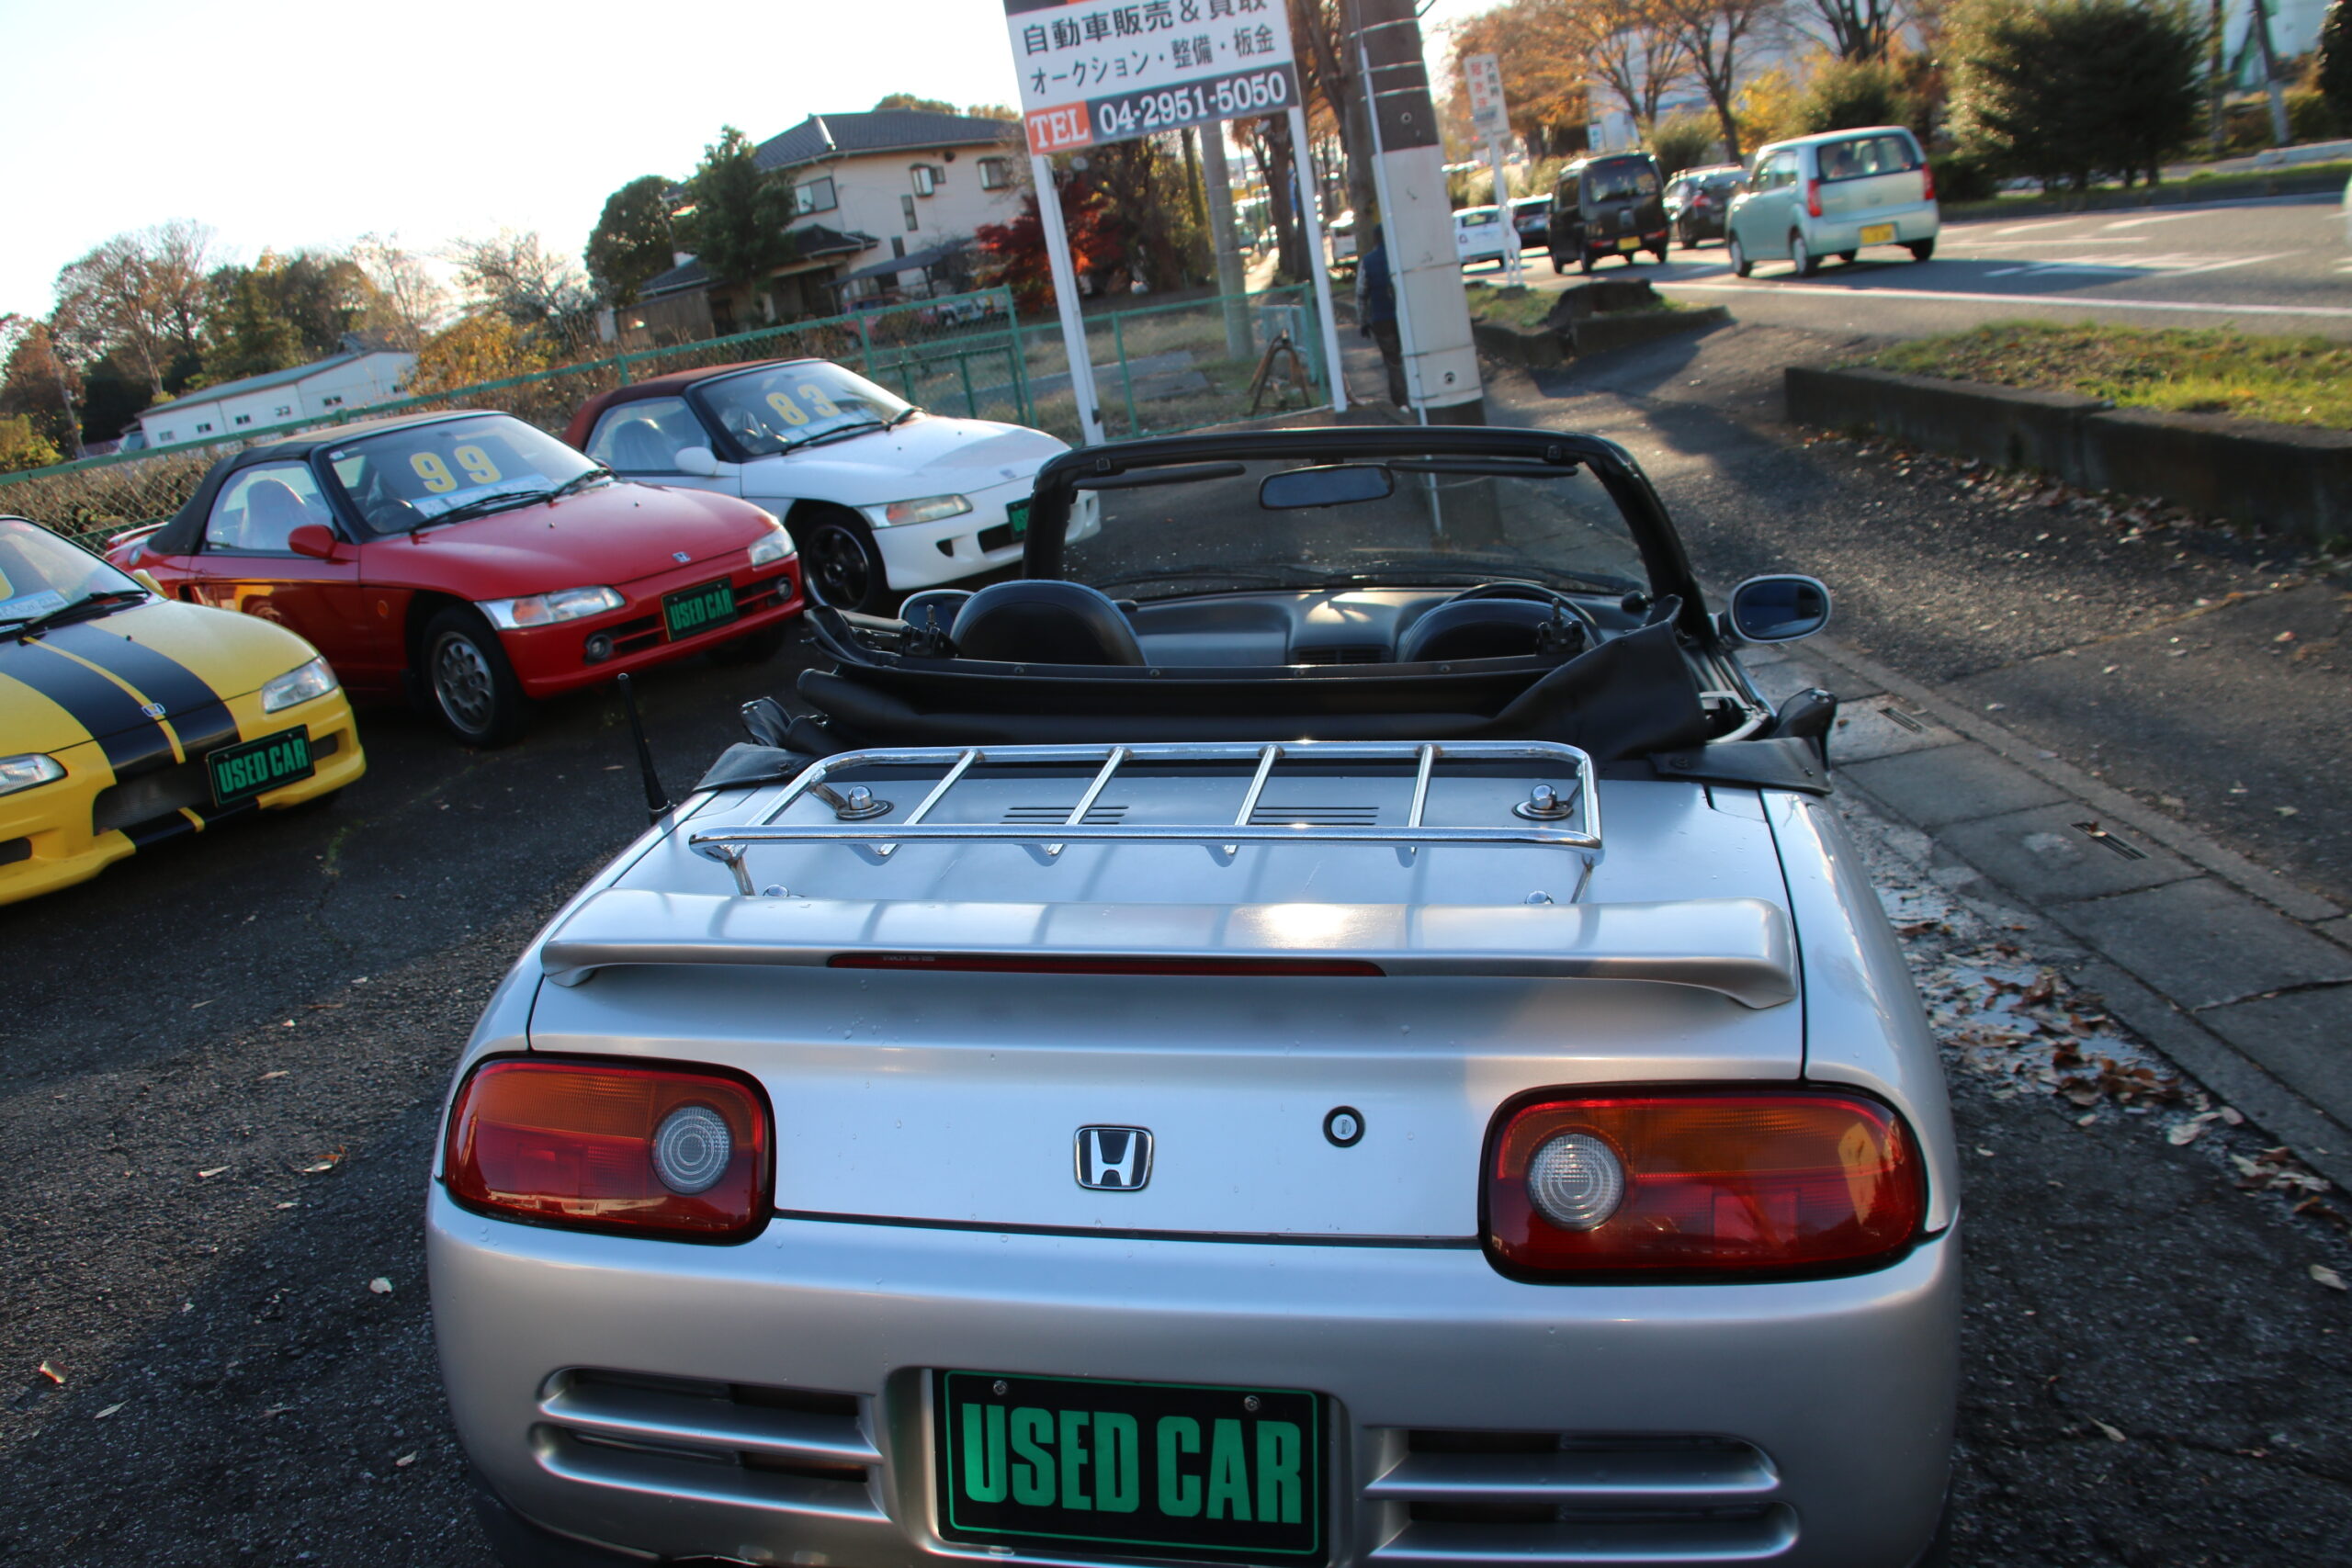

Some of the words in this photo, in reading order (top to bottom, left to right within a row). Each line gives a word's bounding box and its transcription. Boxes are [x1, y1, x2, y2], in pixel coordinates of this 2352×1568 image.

[1029, 107, 1089, 149] TEL
[1098, 70, 1286, 136] 04-2951-5050
[765, 384, 841, 425] 83
[409, 445, 503, 493] 99
[670, 597, 706, 630] USED
[705, 589, 733, 619] CAR
[217, 750, 268, 794] USED
[268, 739, 308, 776] CAR
[962, 1403, 1139, 1513] USED
[1157, 1416, 1302, 1524] CAR
